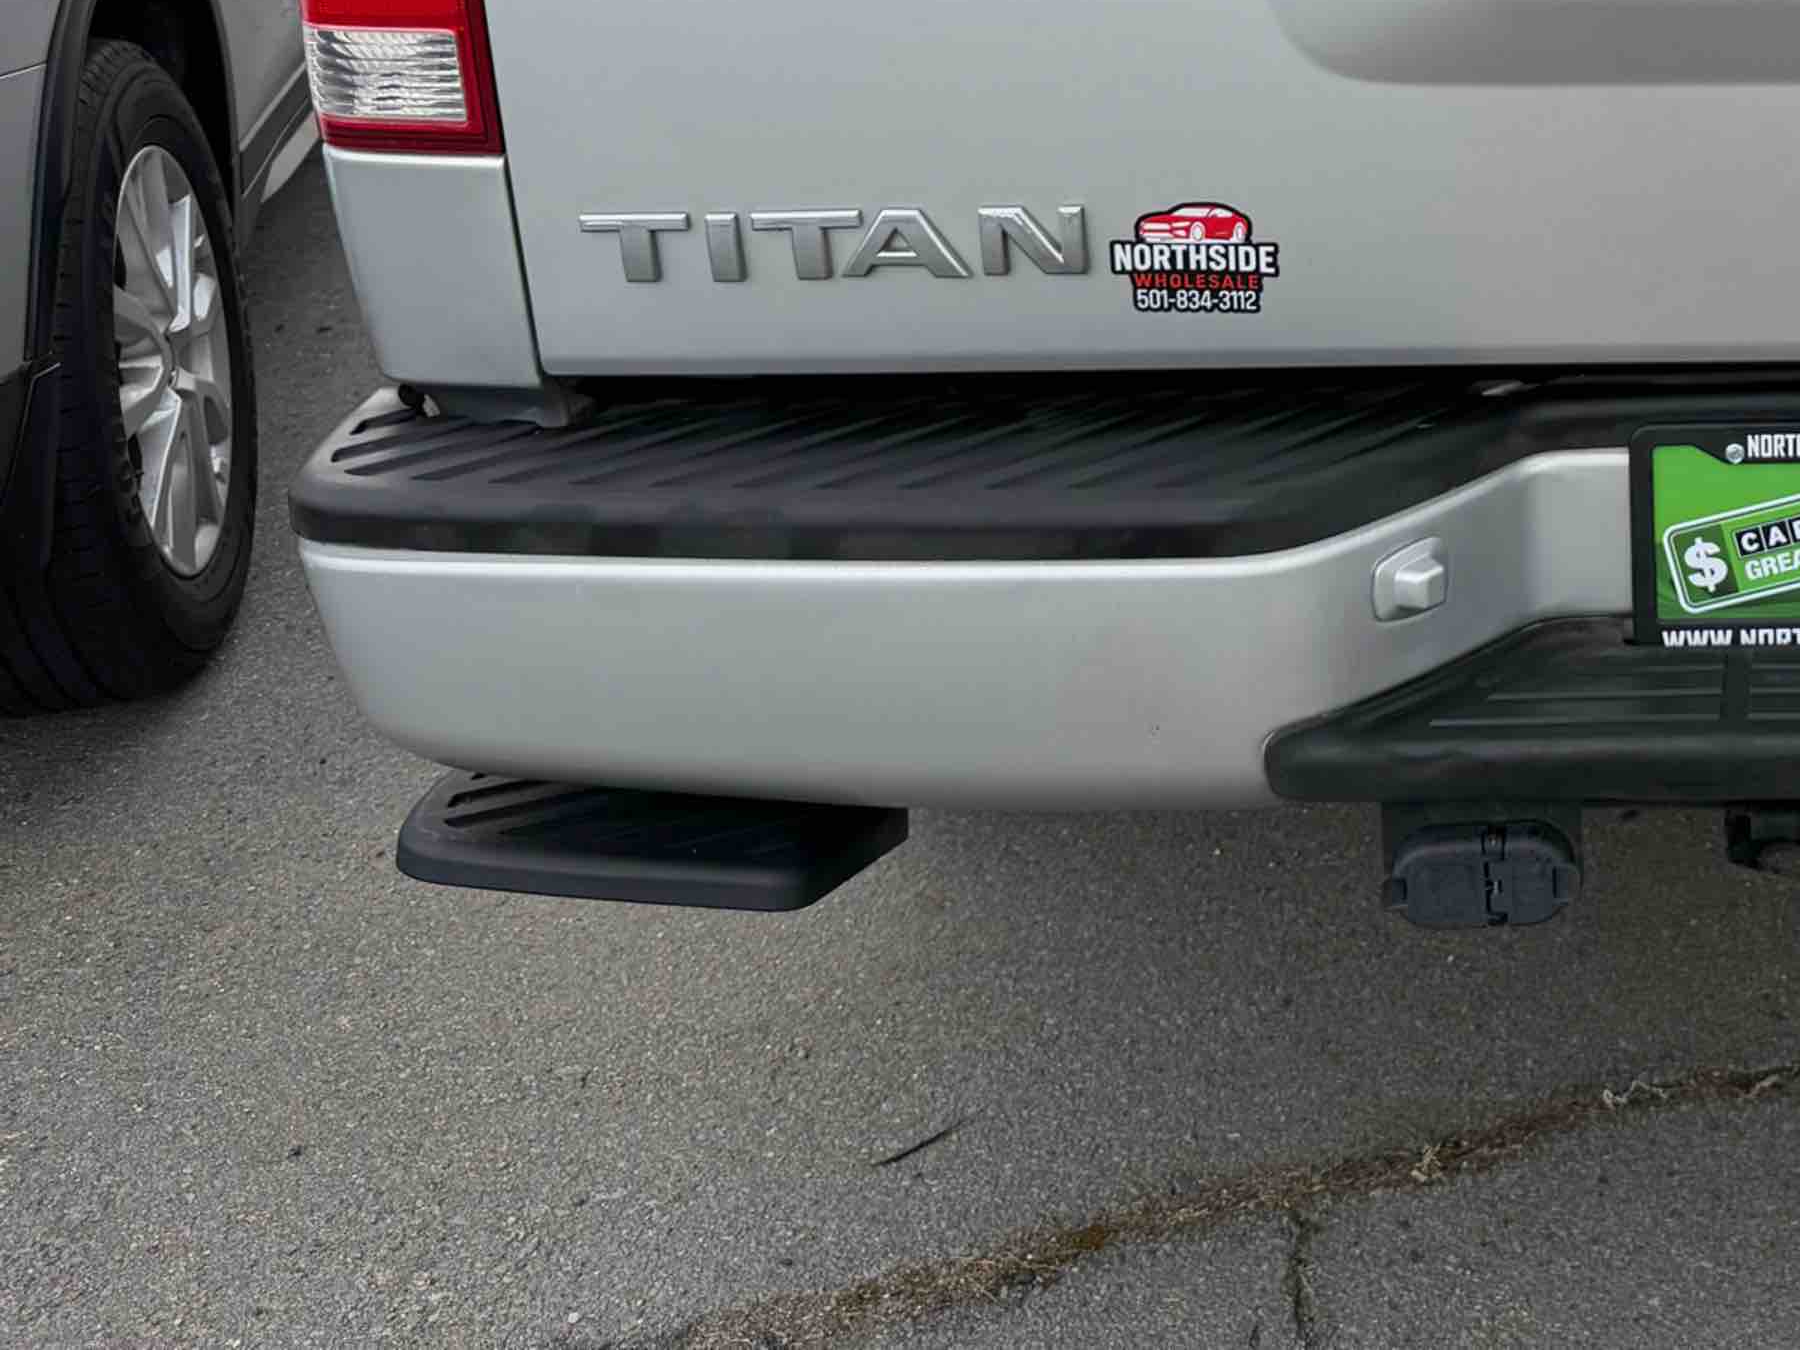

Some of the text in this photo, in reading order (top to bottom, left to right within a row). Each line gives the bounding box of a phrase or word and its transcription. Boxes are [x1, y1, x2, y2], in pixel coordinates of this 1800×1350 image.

[578, 204, 1090, 283] TITAN
[1113, 244, 1276, 273] NORTHSIDE
[1135, 273, 1259, 289] WHOLESALE
[1136, 289, 1257, 310] 501-834-3112
